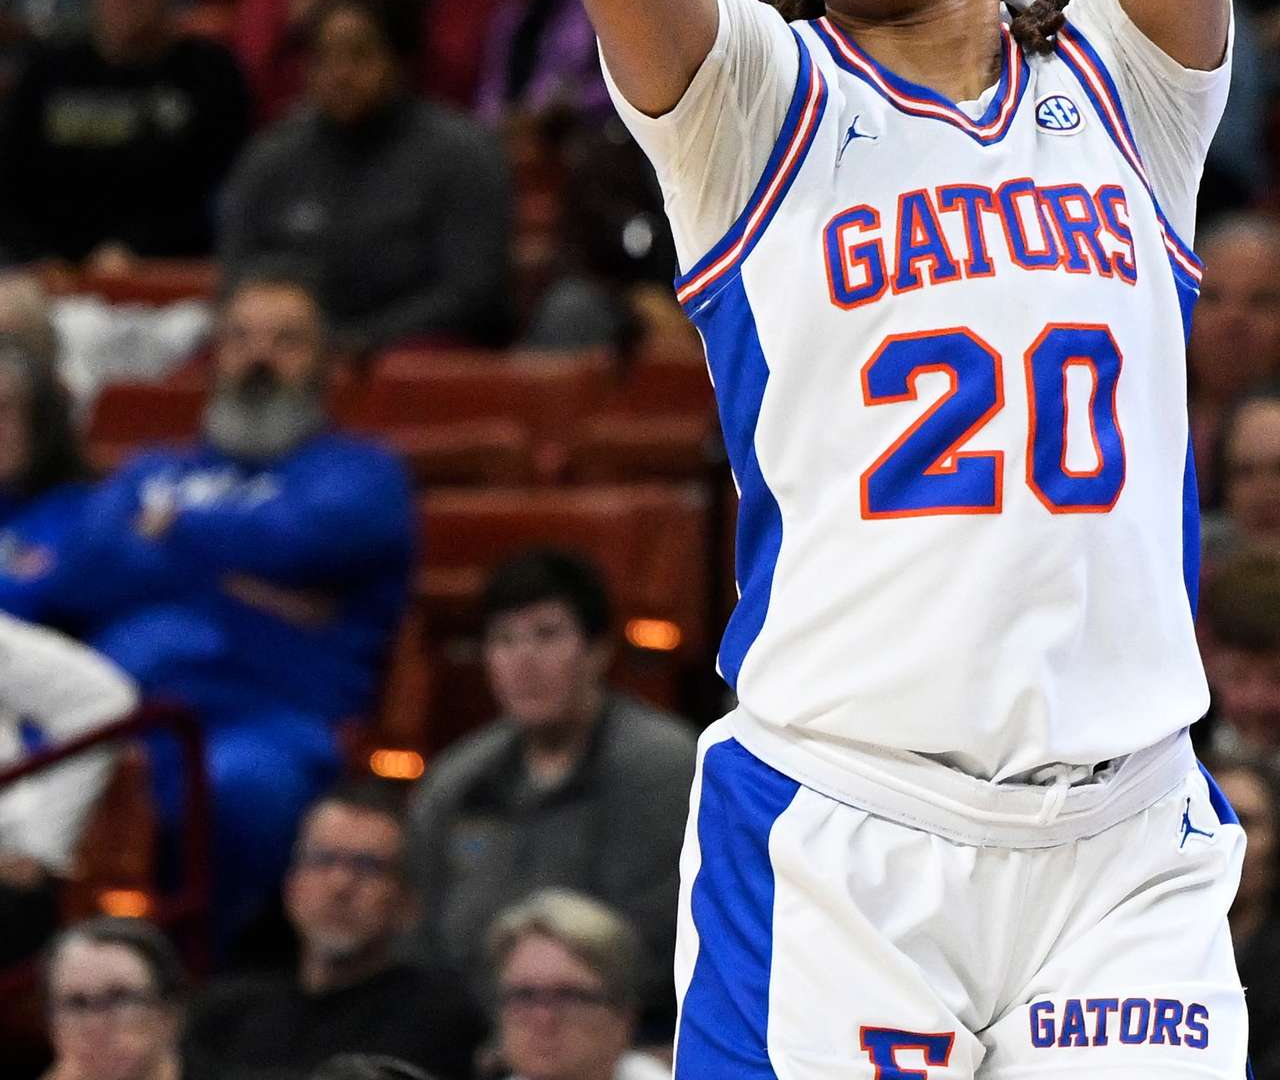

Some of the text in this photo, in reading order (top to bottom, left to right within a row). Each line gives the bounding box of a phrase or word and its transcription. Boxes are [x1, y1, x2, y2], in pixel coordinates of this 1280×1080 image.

[1037, 96, 1080, 130] SEC
[823, 177, 1138, 310] GATORS
[860, 323, 1126, 520] 20
[1029, 997, 1210, 1050] GATORS
